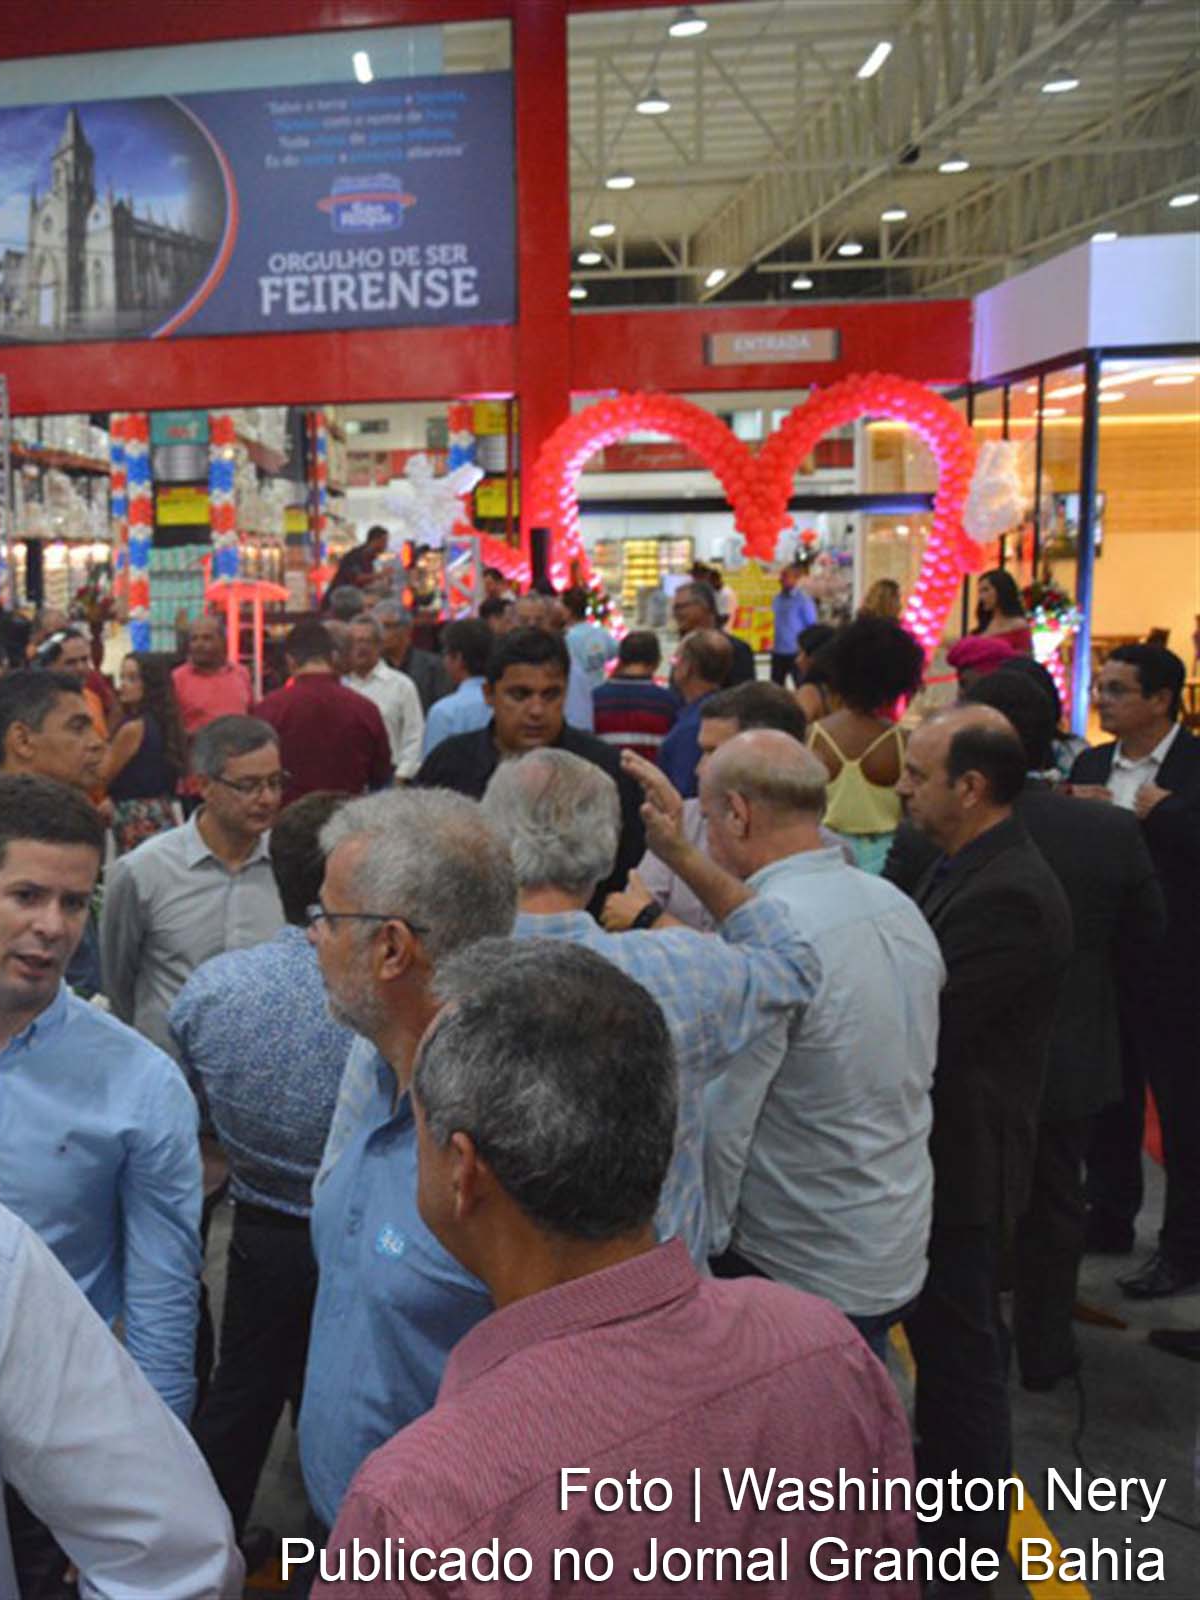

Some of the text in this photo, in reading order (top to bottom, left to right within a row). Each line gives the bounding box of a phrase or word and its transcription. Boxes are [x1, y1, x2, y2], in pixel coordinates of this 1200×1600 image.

[268, 243, 468, 274] ORGULHO DE SER
[258, 267, 480, 315] FEIRENSE
